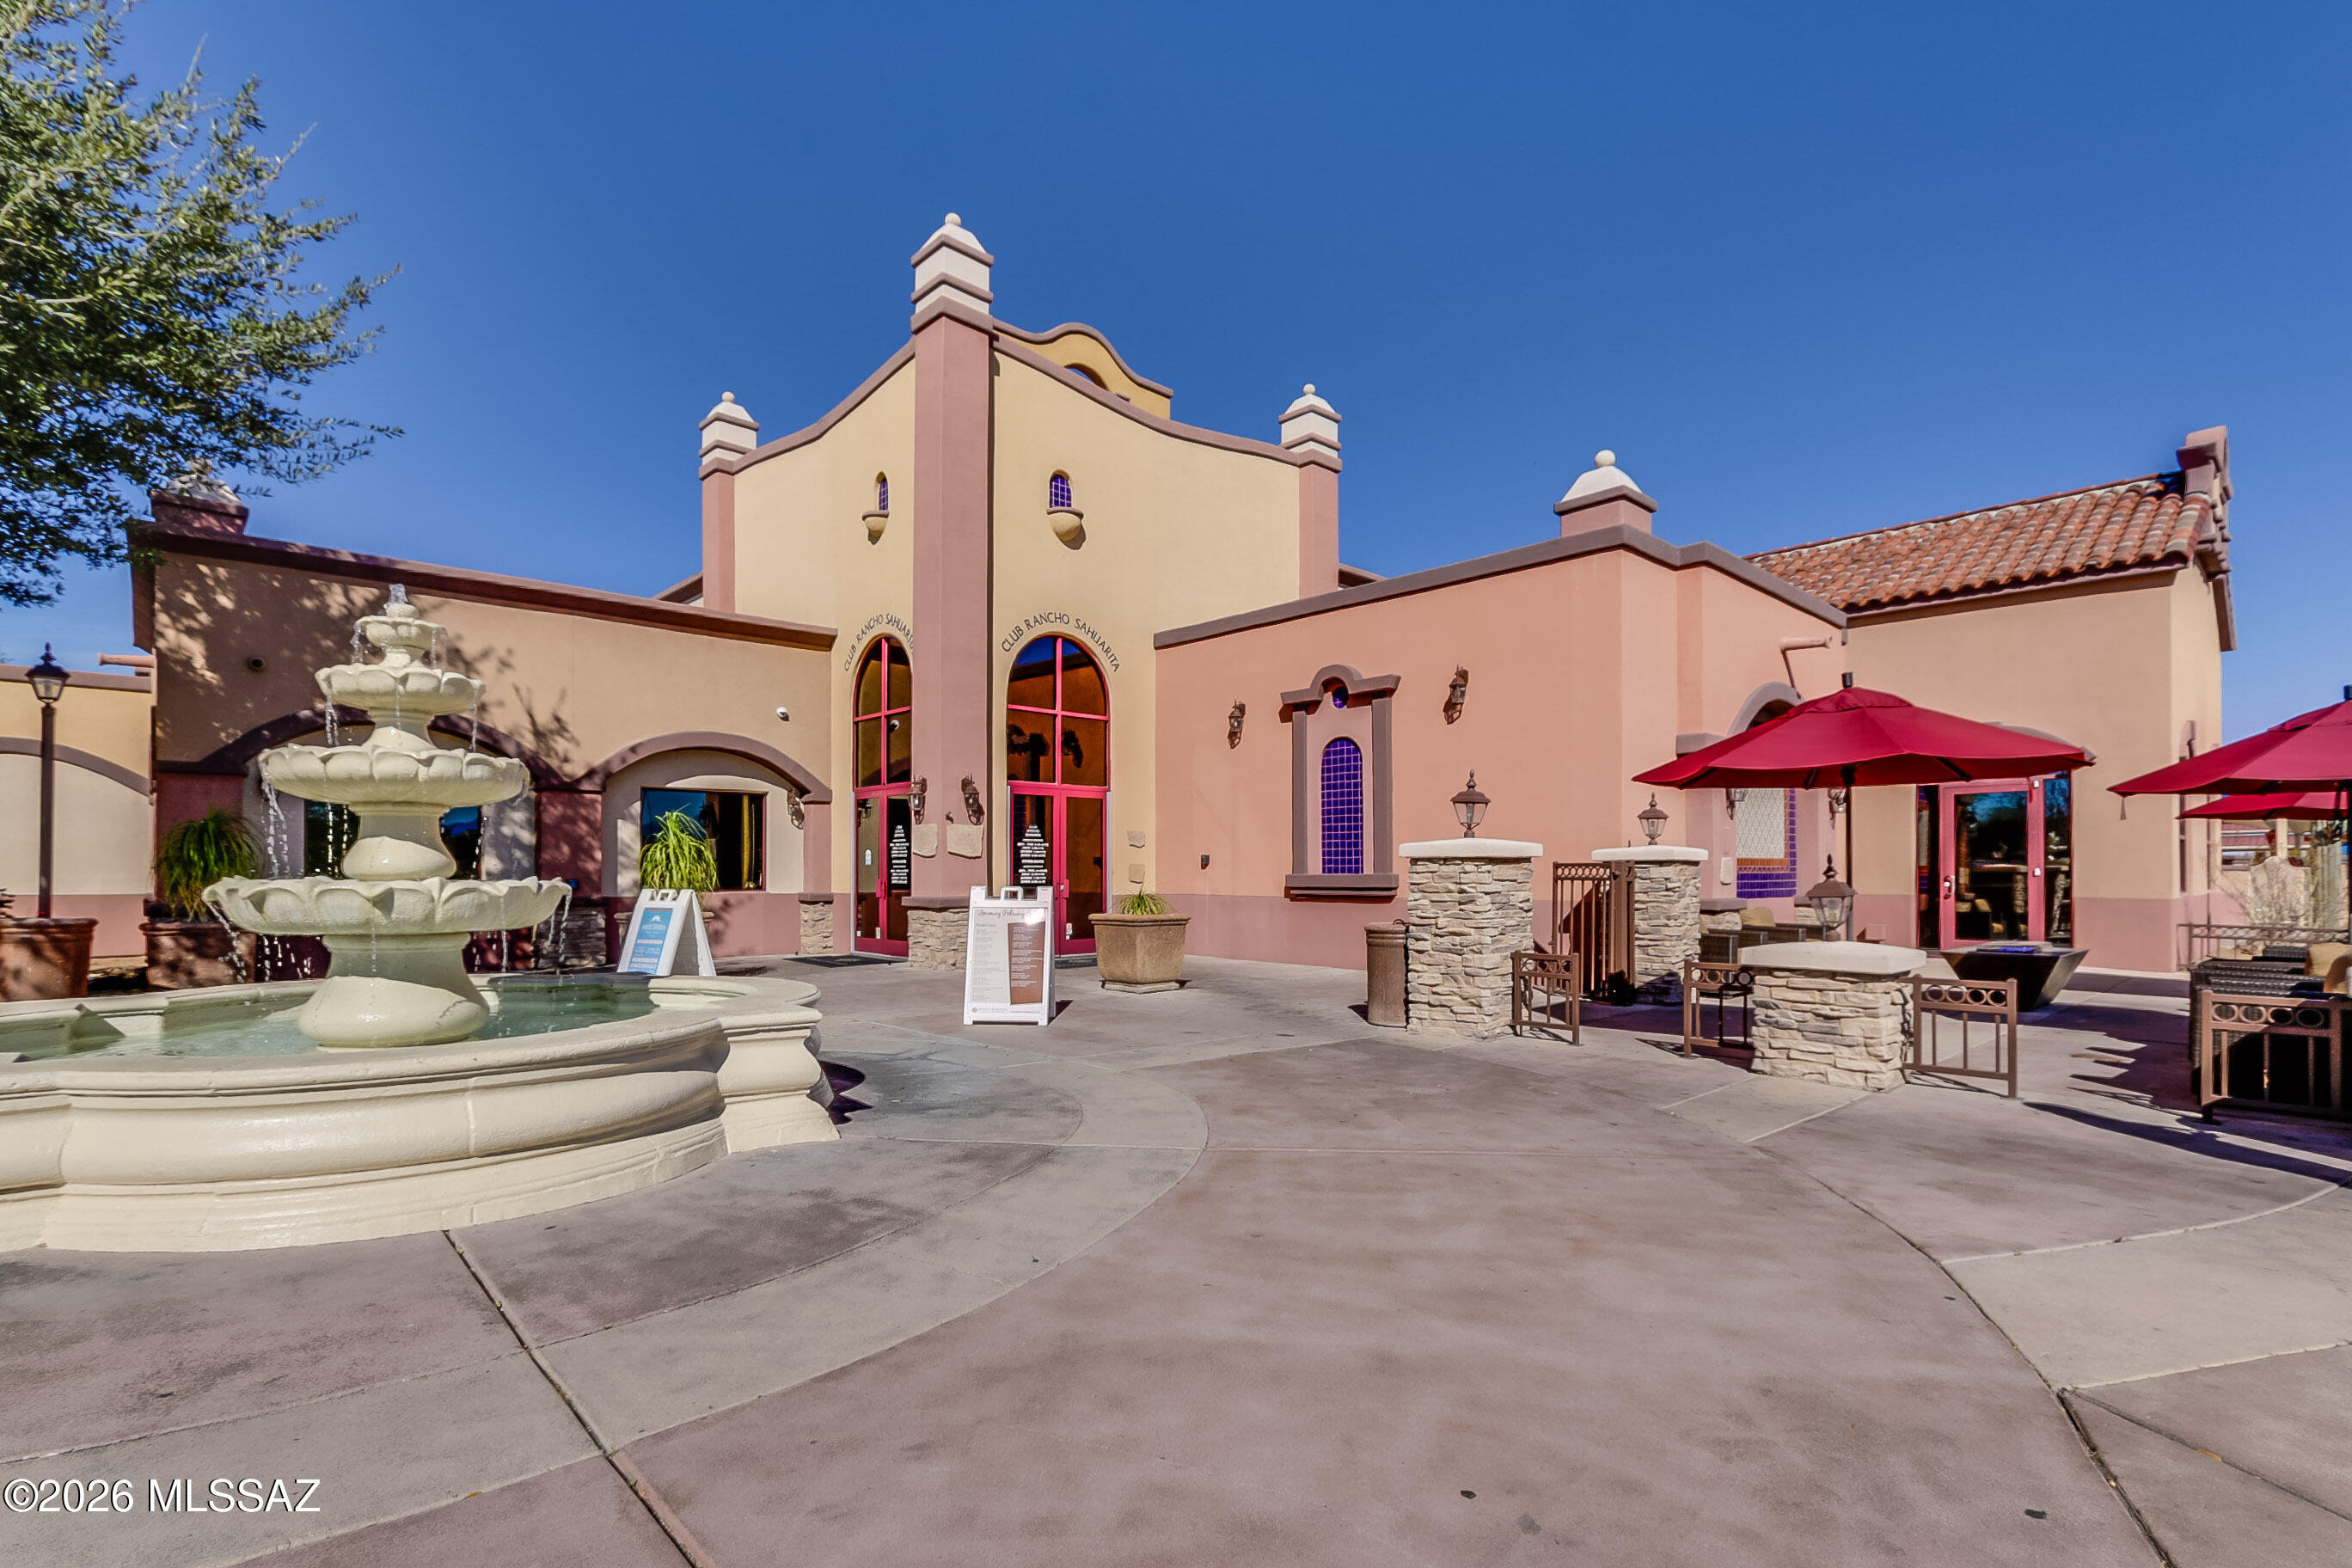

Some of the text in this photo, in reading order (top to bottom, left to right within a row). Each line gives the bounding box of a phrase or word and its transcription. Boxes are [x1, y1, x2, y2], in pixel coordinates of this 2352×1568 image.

[844, 644, 856, 671] CLUB
[856, 614, 884, 644] RANCHO
[1001, 612, 1120, 672] CLUB RANCHO SAHUARITA
